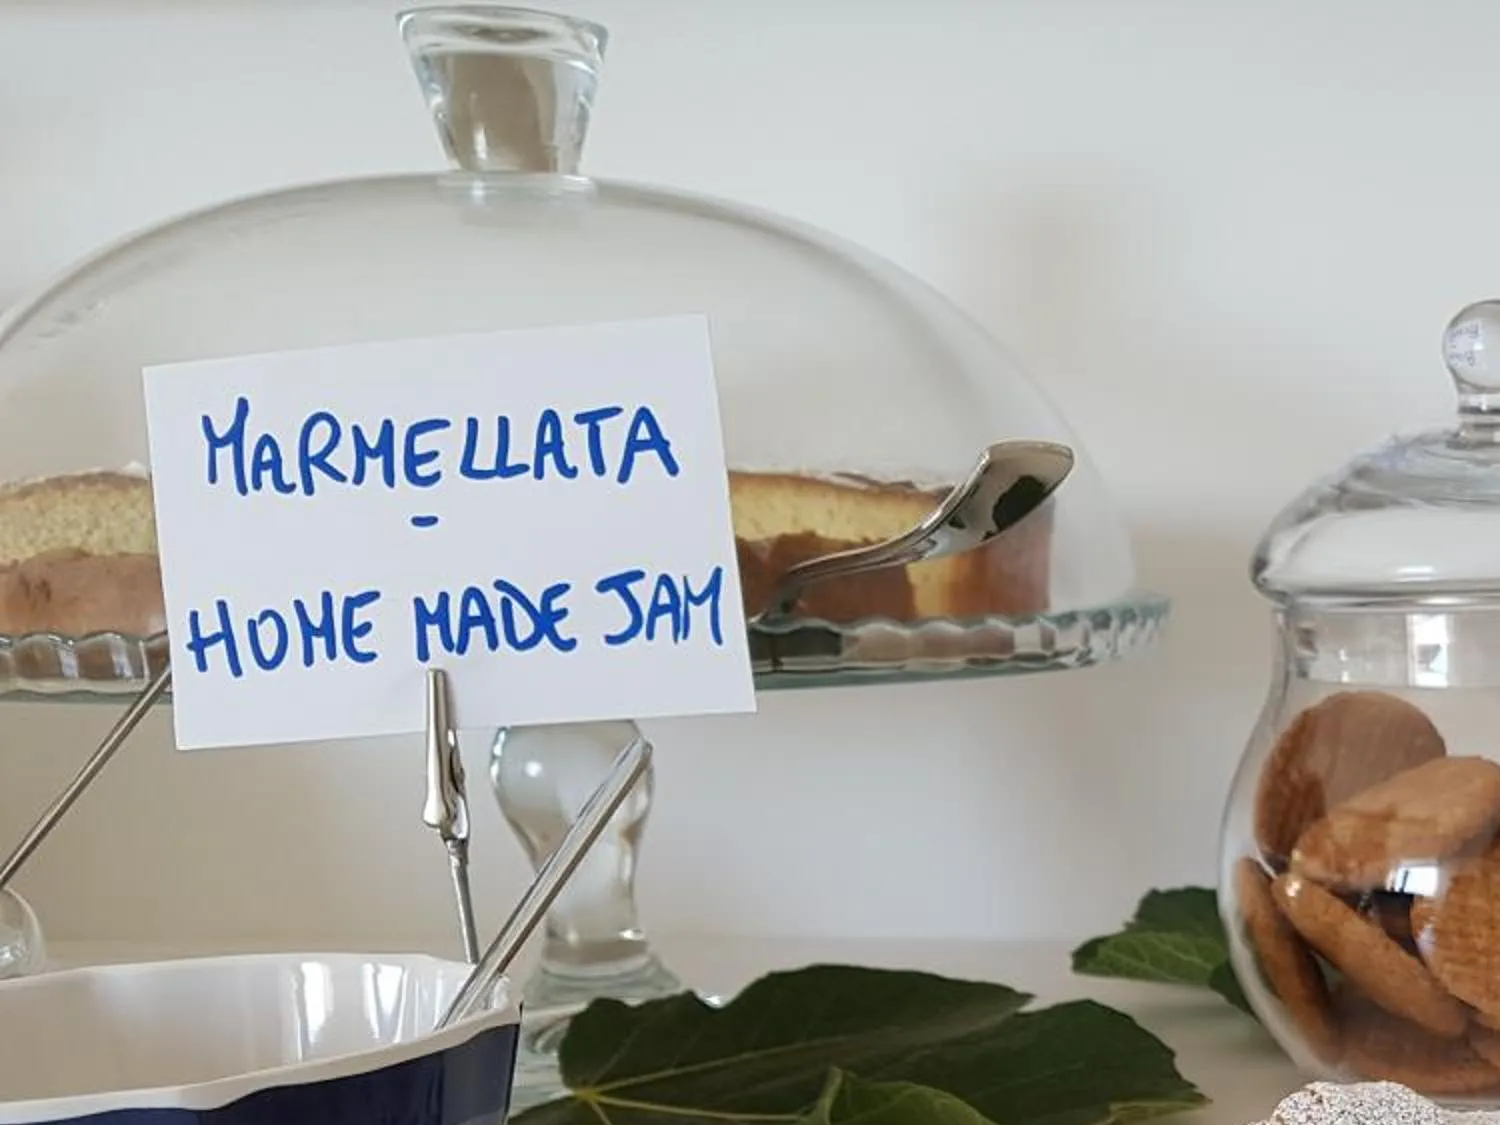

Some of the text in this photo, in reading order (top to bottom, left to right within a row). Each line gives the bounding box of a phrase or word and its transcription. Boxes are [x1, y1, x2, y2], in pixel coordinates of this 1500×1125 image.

[200, 397, 681, 497] MARMELLATA
[187, 566, 726, 679] HOME MADE JAM
